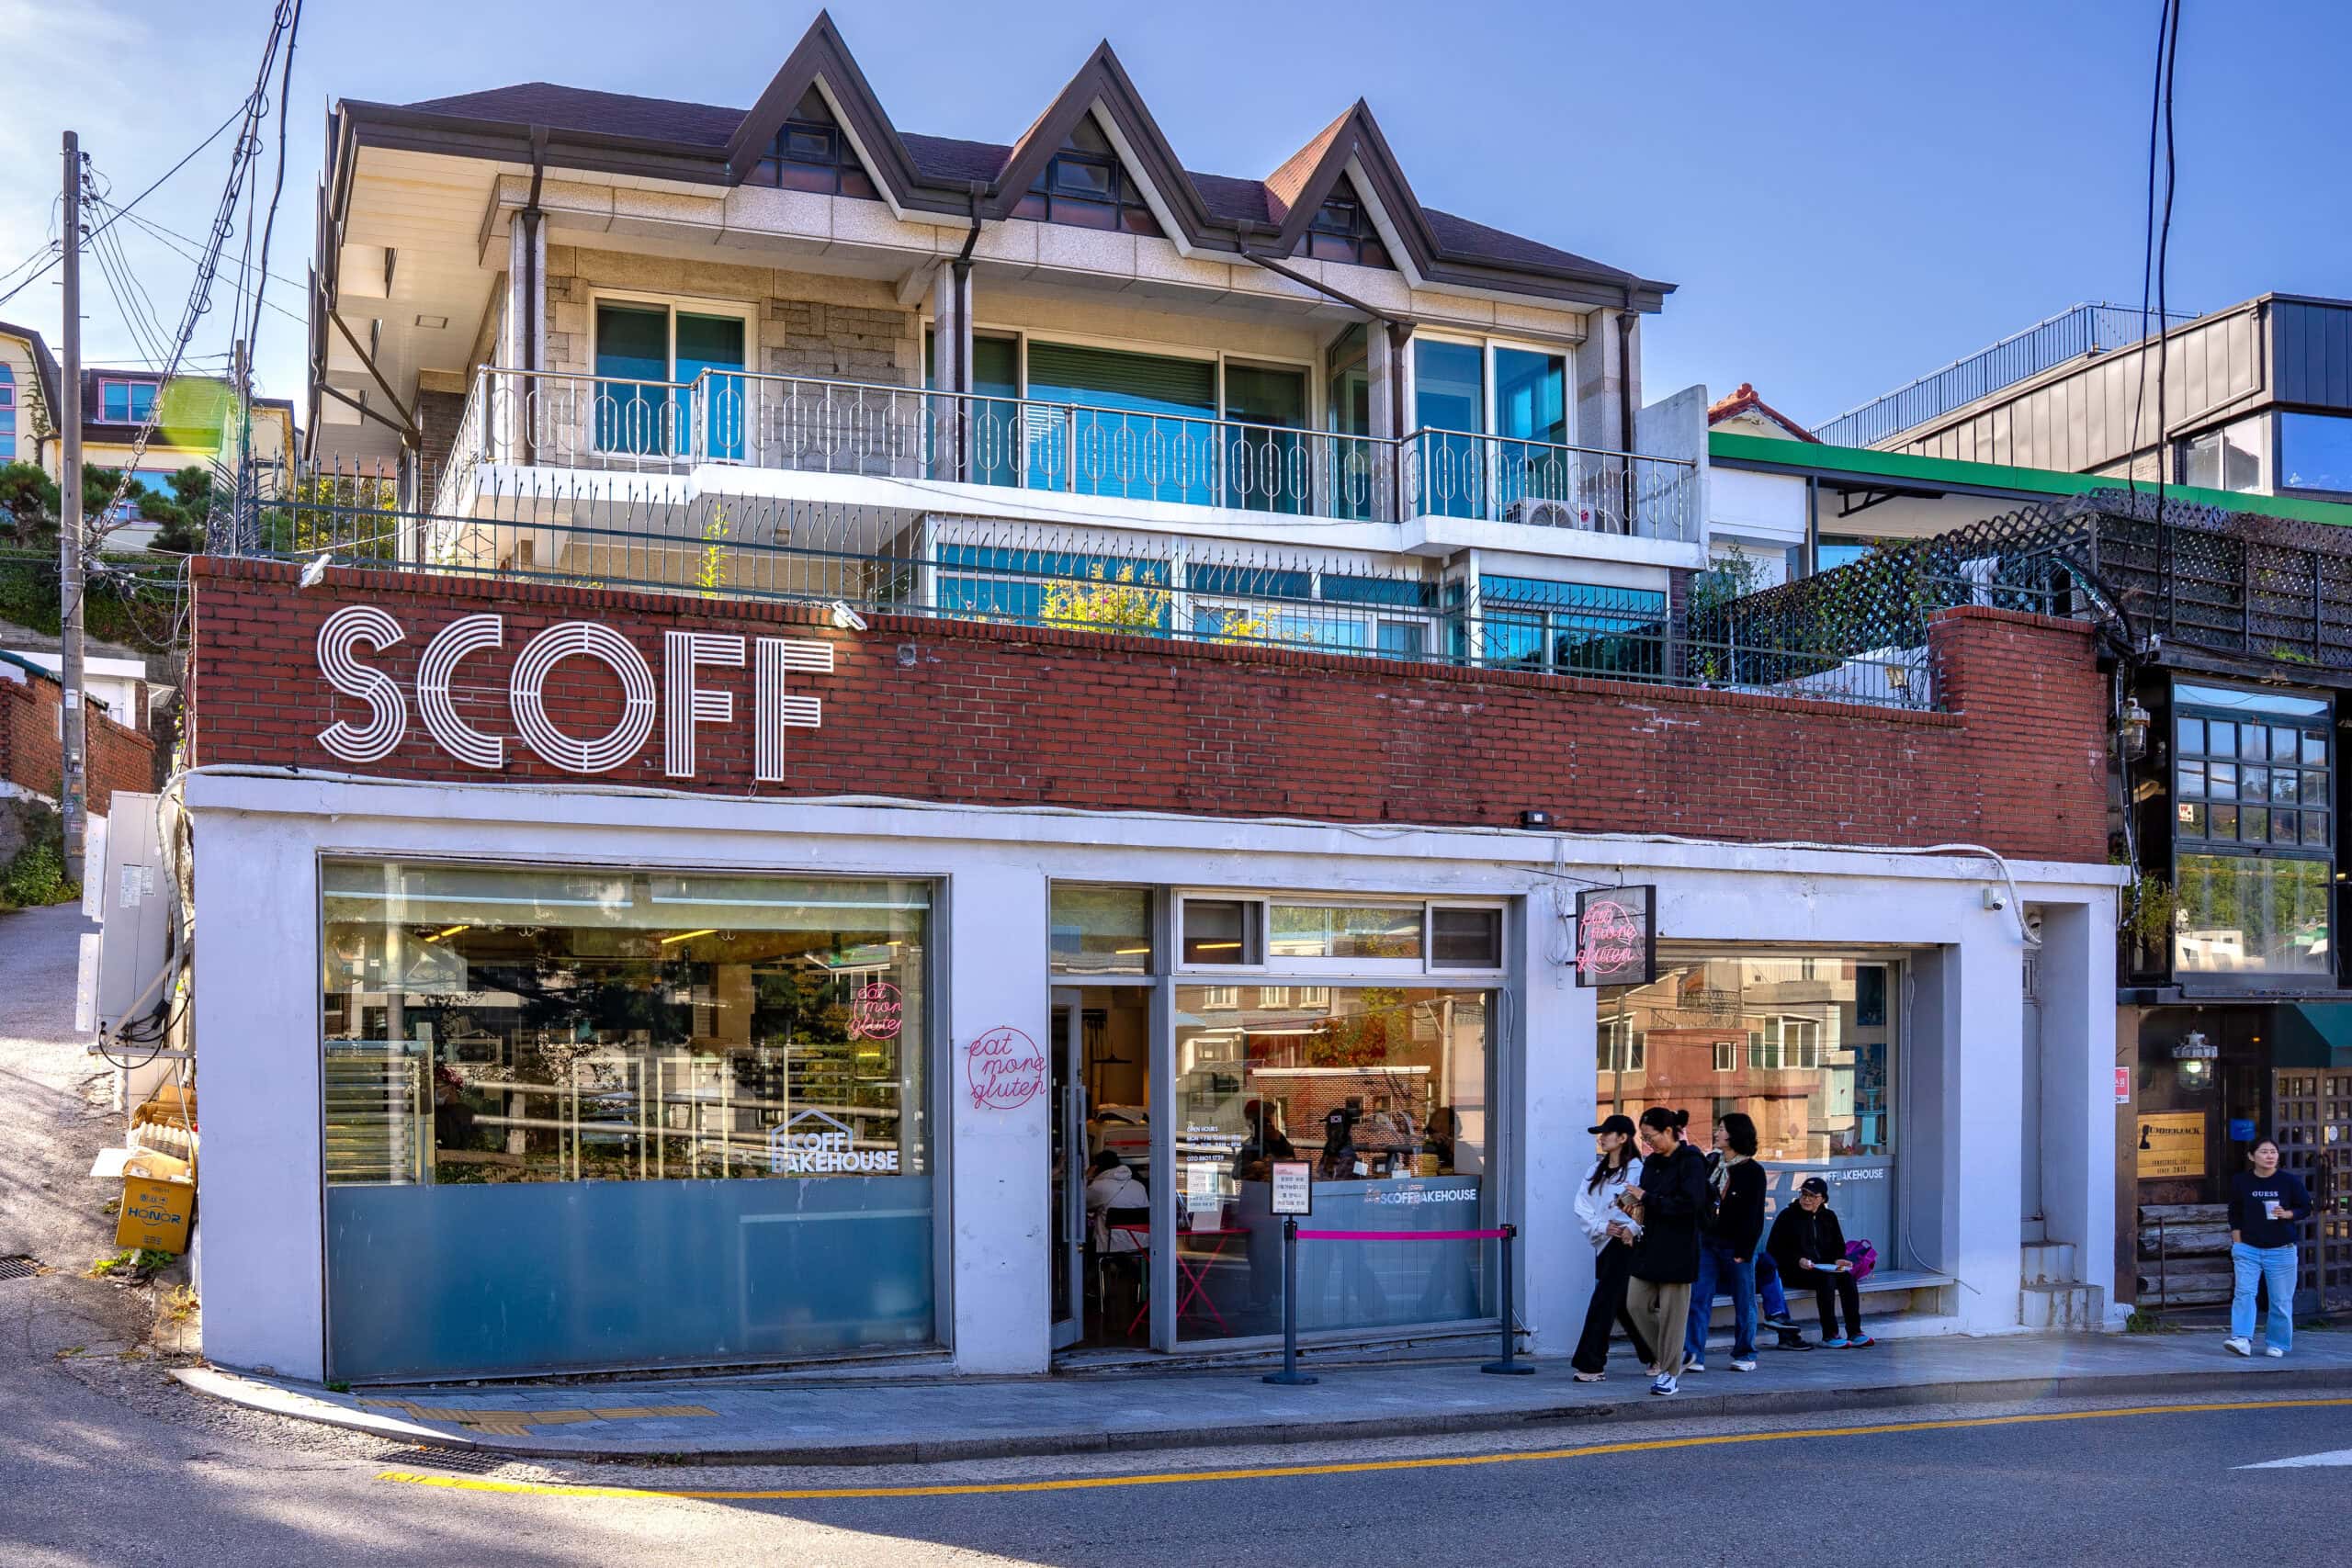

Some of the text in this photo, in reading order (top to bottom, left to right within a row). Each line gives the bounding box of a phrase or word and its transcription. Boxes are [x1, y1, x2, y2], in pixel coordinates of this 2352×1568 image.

[316, 604, 834, 783] SCOFF
[1582, 907, 1613, 926] eat
[1589, 925, 1638, 940] more
[1576, 940, 1634, 973] gluten
[857, 984, 887, 999] eat
[970, 1033, 1012, 1056] eat
[981, 1056, 1046, 1075] more
[970, 1074, 1046, 1109] gluten
[128, 1207, 182, 1224] HONOR
